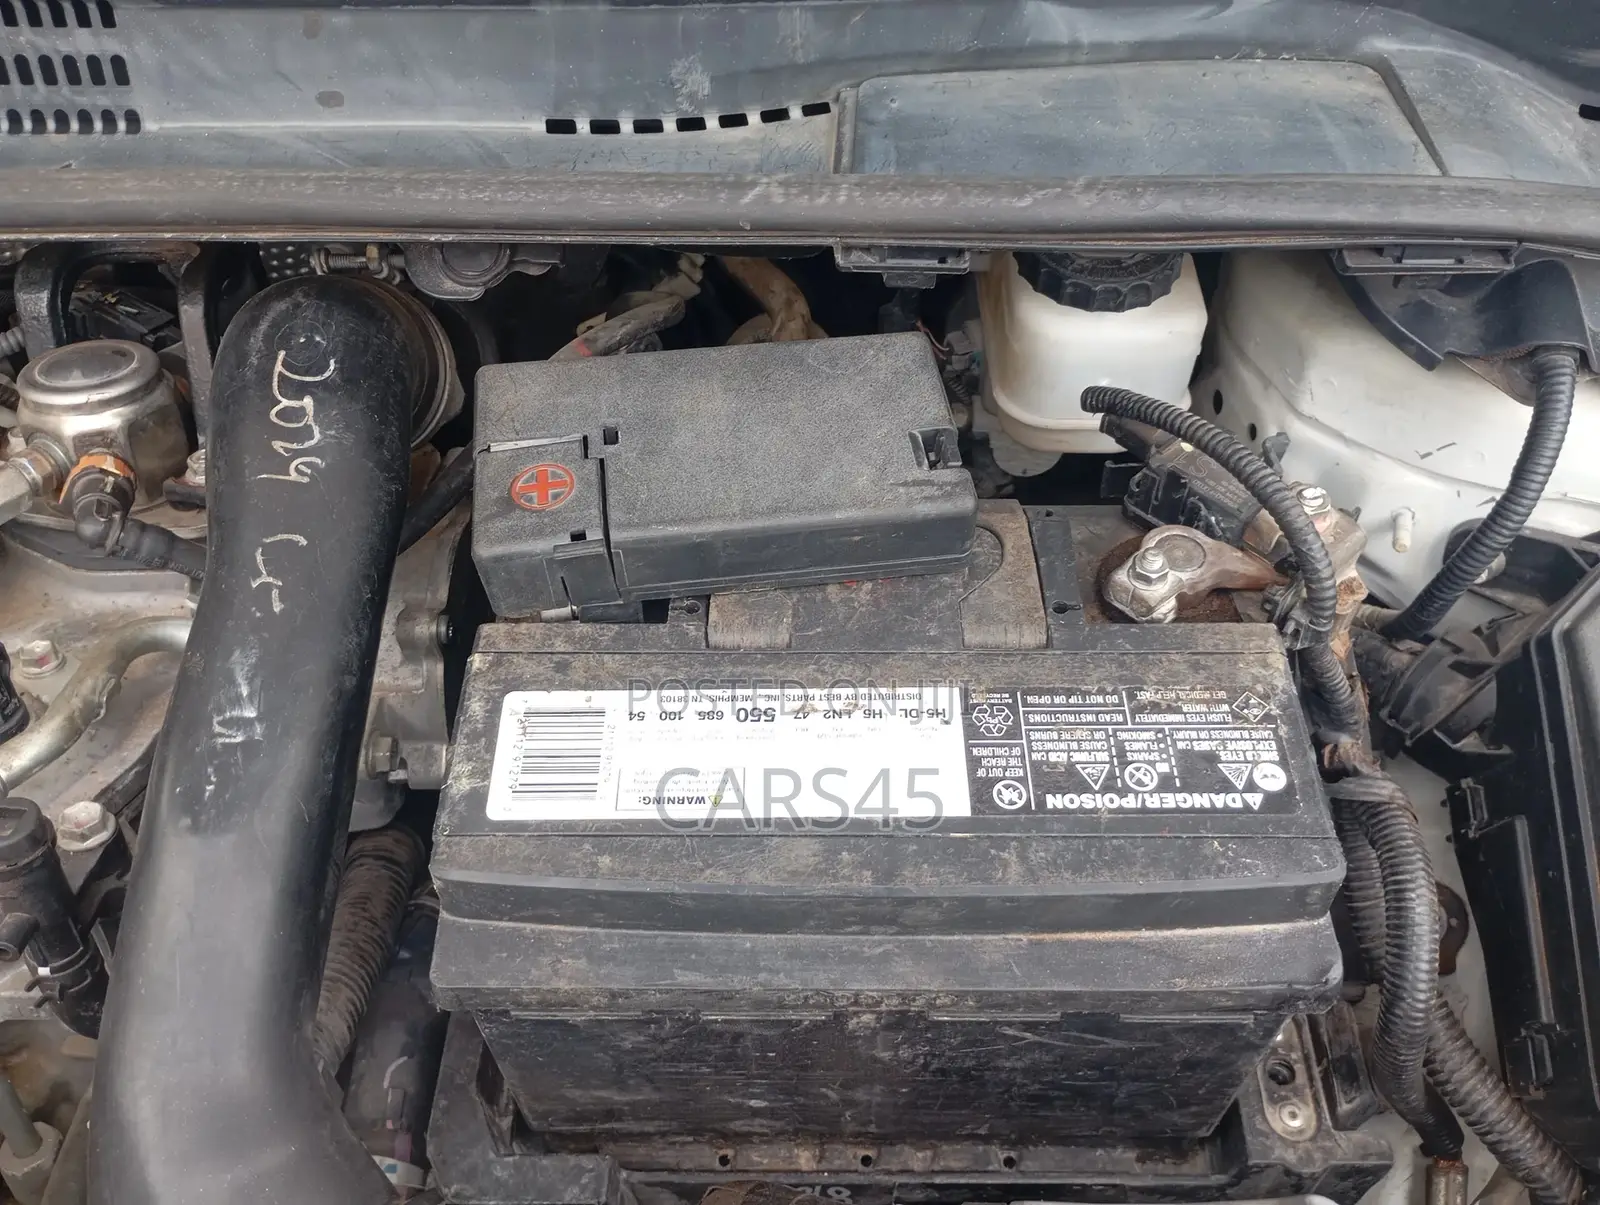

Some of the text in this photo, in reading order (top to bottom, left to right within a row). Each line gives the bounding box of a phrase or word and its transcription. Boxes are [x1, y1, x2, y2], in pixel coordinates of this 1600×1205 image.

[660, 694, 688, 703] 38103
[705, 694, 753, 703] MEMPHIS,
[817, 693, 842, 702] BEST
[844, 692, 858, 701] BY
[860, 692, 922, 701] DISTRIBUTED
[1053, 695, 1066, 703] OR
[1068, 695, 1083, 703] TIP
[1085, 695, 1104, 703] NOT
[1106, 695, 1119, 703] DO
[627, 711, 646, 721] 54
[658, 710, 685, 721] 100
[697, 710, 725, 721] 685
[736, 707, 777, 723] 550
[792, 709, 811, 720] 47
[862, 708, 883, 719] H5
[1025, 713, 1124, 722] READ INSTRUCTIONS.
[1186, 713, 1205, 722] EYES
[1206, 713, 1232, 722] FLUSH
[1092, 731, 1106, 739] OR
[1116, 731, 1155, 740] SMOKING
[1210, 730, 1249, 739] BLINDNESS
[1250, 730, 1273, 739] CAUSE
[1031, 741, 1107, 750] CAUSE BLINDNESS
[1124, 741, 1158, 750] FLAMES
[970, 747, 1021, 756] OF CHILDREN.
[1031, 752, 1047, 760] CAN
[1126, 752, 1160, 761] SPARKS
[981, 757, 1022, 766] THE REACH
[976, 768, 1024, 777] KEEP OUT OF
[637, 795, 706, 805] WARNING:
[1046, 793, 1244, 809] DANGER/POISON
